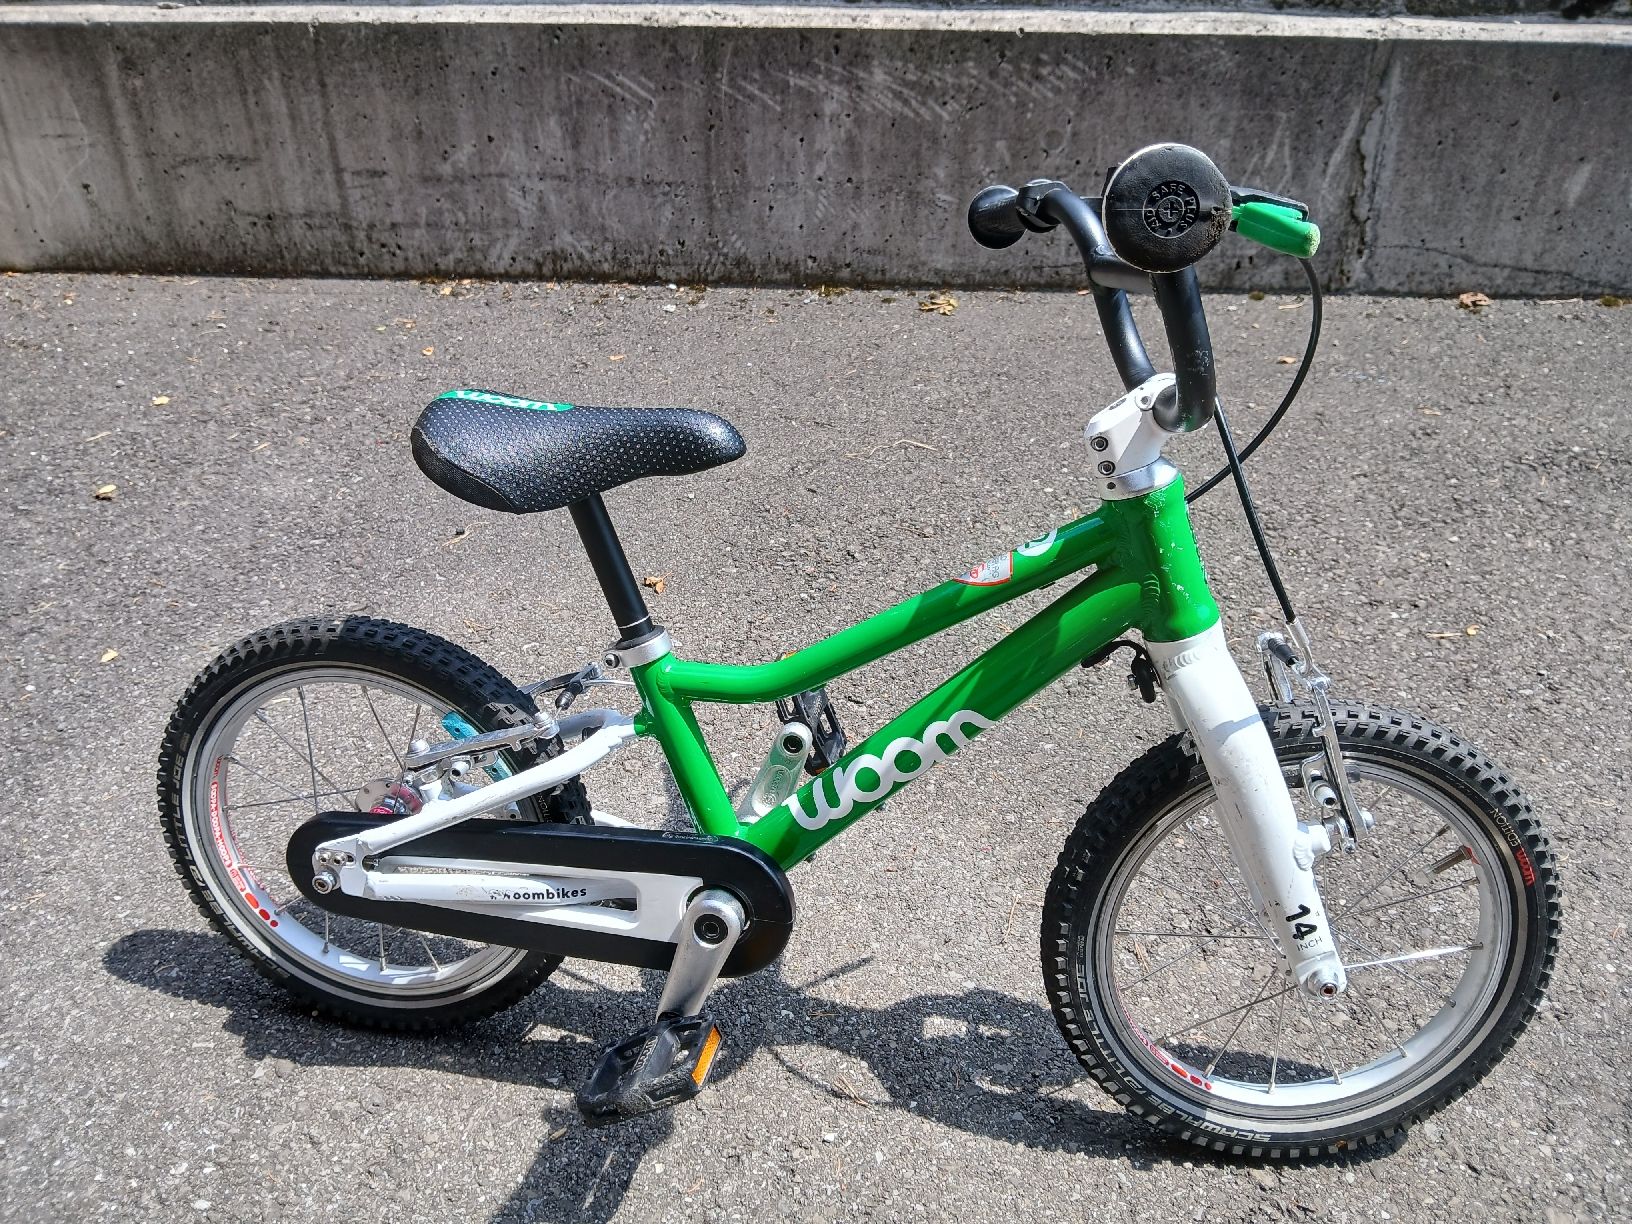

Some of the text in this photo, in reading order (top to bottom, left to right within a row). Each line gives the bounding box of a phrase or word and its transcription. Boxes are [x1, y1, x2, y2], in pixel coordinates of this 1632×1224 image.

[1151, 183, 1186, 200] SAFE
[1180, 196, 1197, 229] PLUS
[781, 709, 997, 831] woom
[1488, 807, 1520, 847] EDITION
[1285, 903, 1318, 941] 14
[1296, 936, 1323, 952] INCH
[1083, 1009, 1126, 1076] LITTLE
[1147, 1096, 1272, 1143] SCHWALBE
